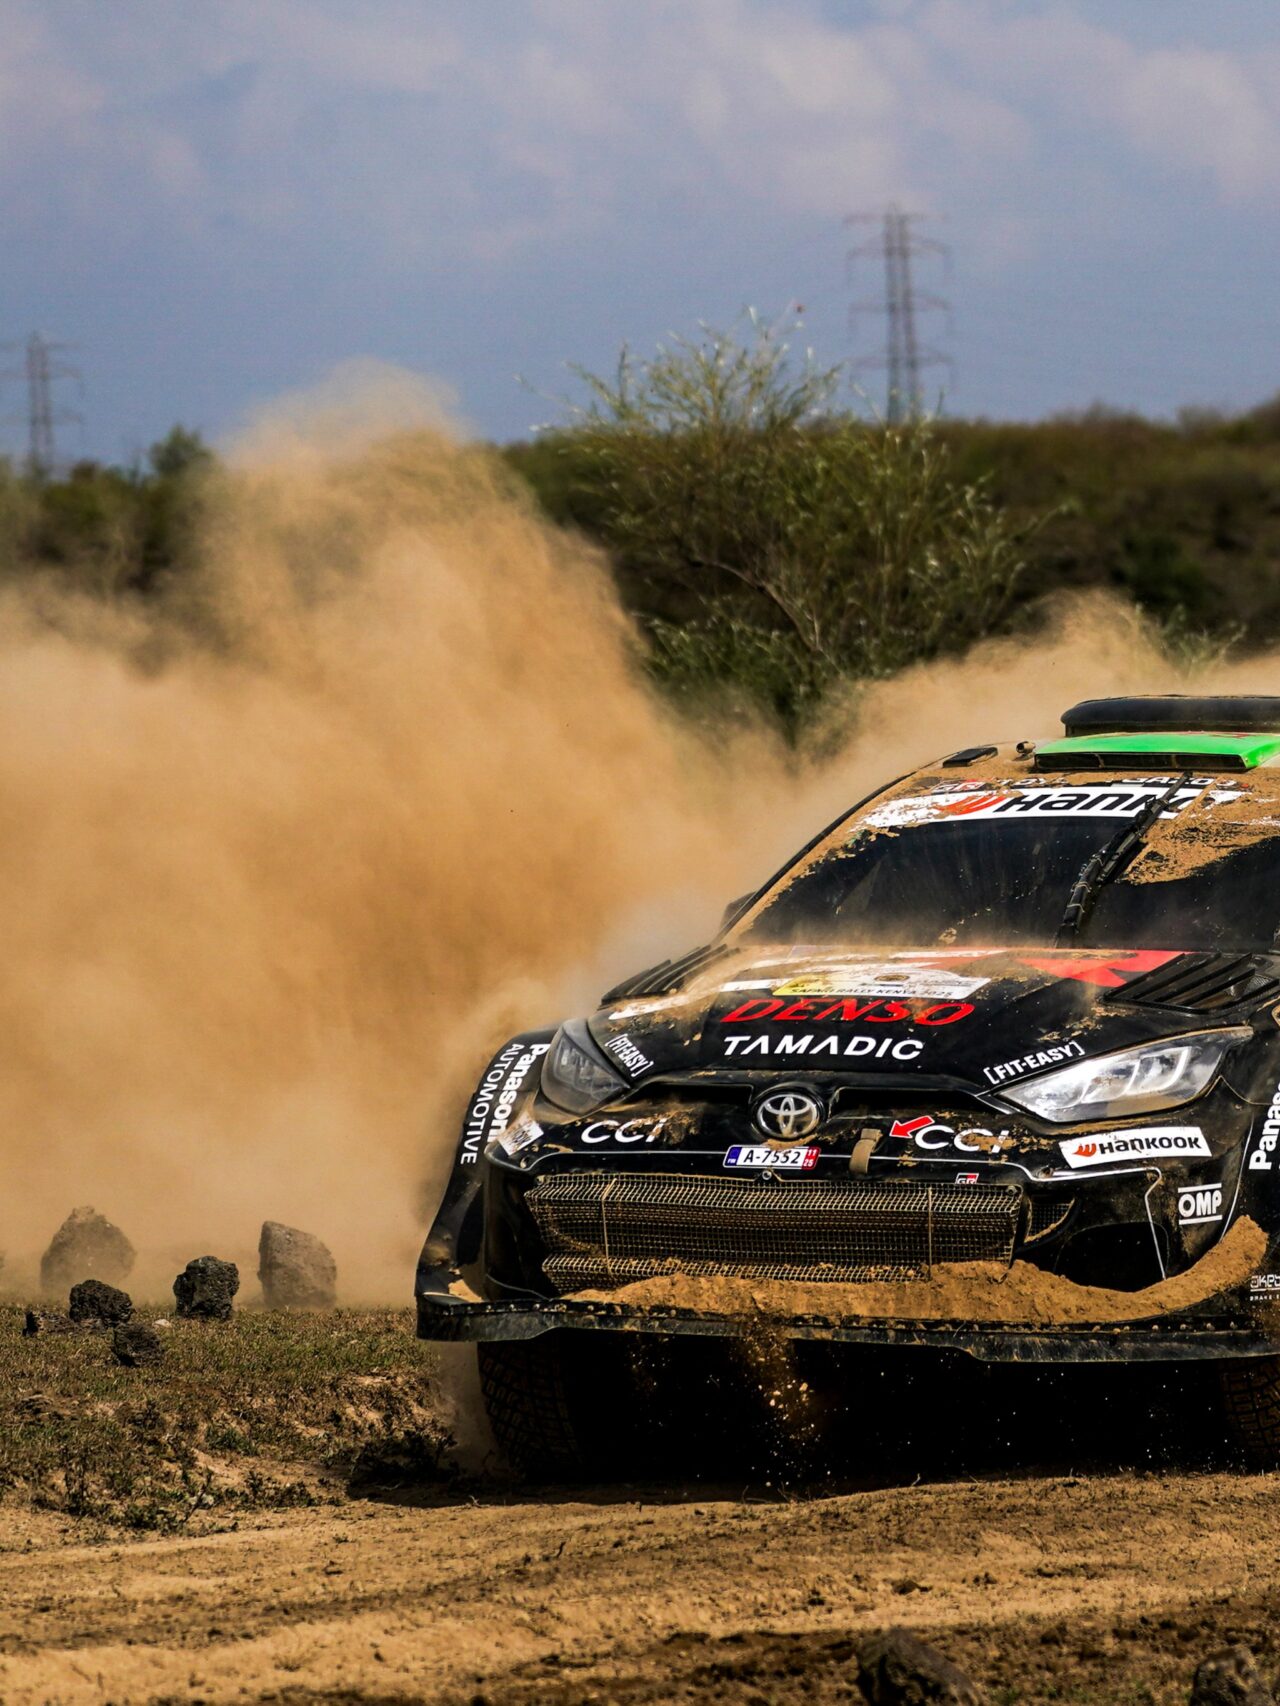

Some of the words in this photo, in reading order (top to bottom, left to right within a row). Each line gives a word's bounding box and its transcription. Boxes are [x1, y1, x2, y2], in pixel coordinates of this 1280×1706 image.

[720, 998, 976, 1026] DENSO
[723, 1034, 926, 1061] TAMADIC
[460, 1043, 525, 1165] AUTOMOTIVE
[743, 1149, 801, 1165] A-7552
[803, 1158, 814, 1167] 25
[1178, 1189, 1223, 1218] OMP
